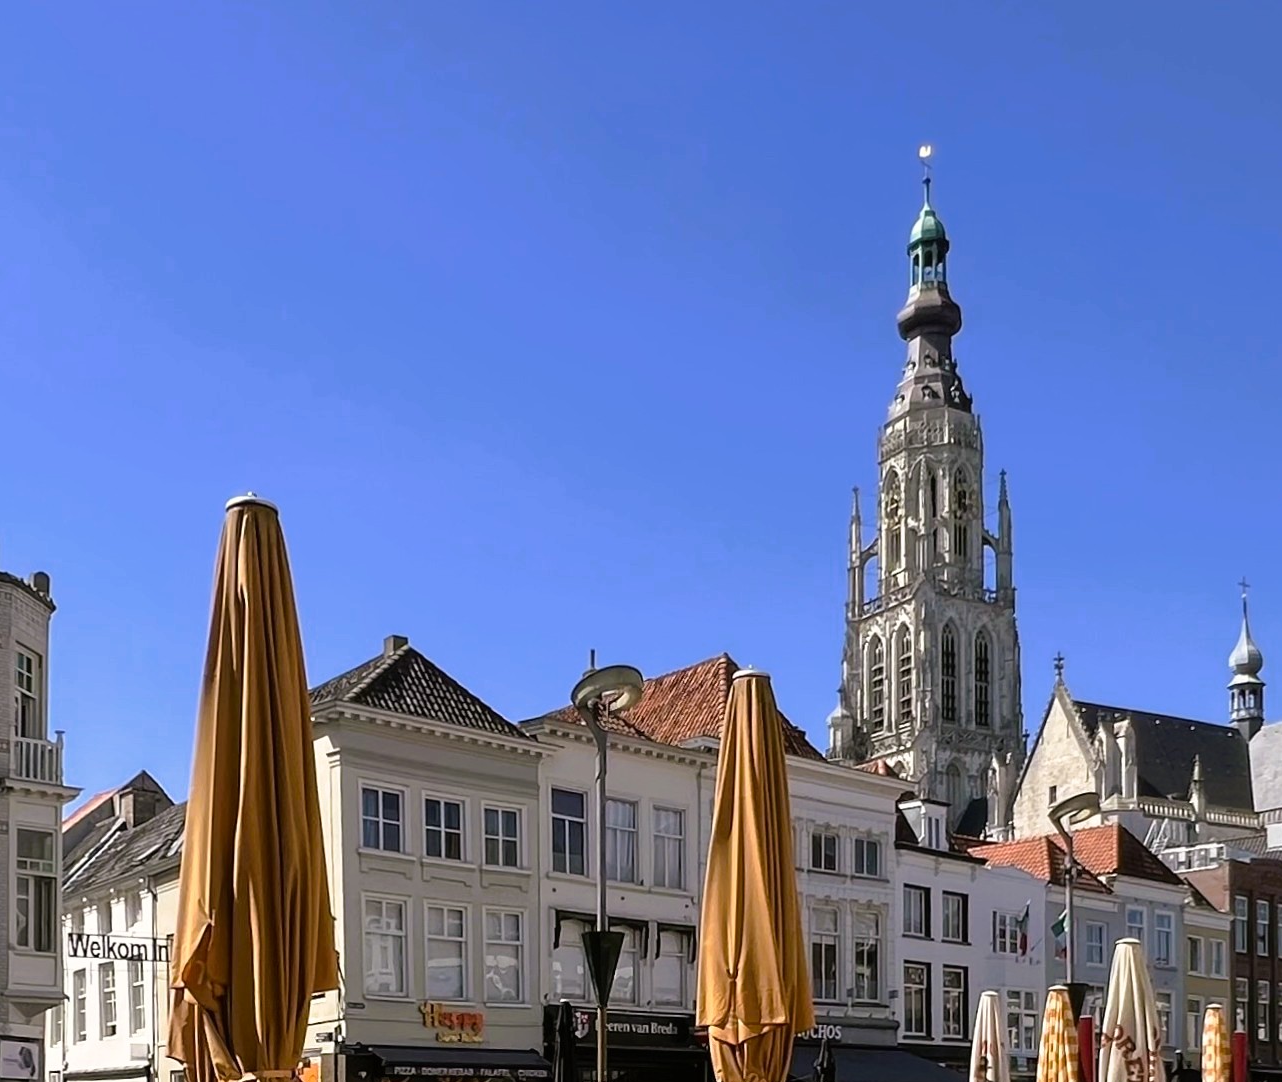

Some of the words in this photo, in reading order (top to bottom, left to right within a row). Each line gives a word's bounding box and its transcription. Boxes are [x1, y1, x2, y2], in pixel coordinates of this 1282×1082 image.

[68, 933, 148, 961] Welkom
[632, 1023, 650, 1034] van
[651, 1021, 678, 1035] Breda
[393, 1066, 417, 1076] PIZZA
